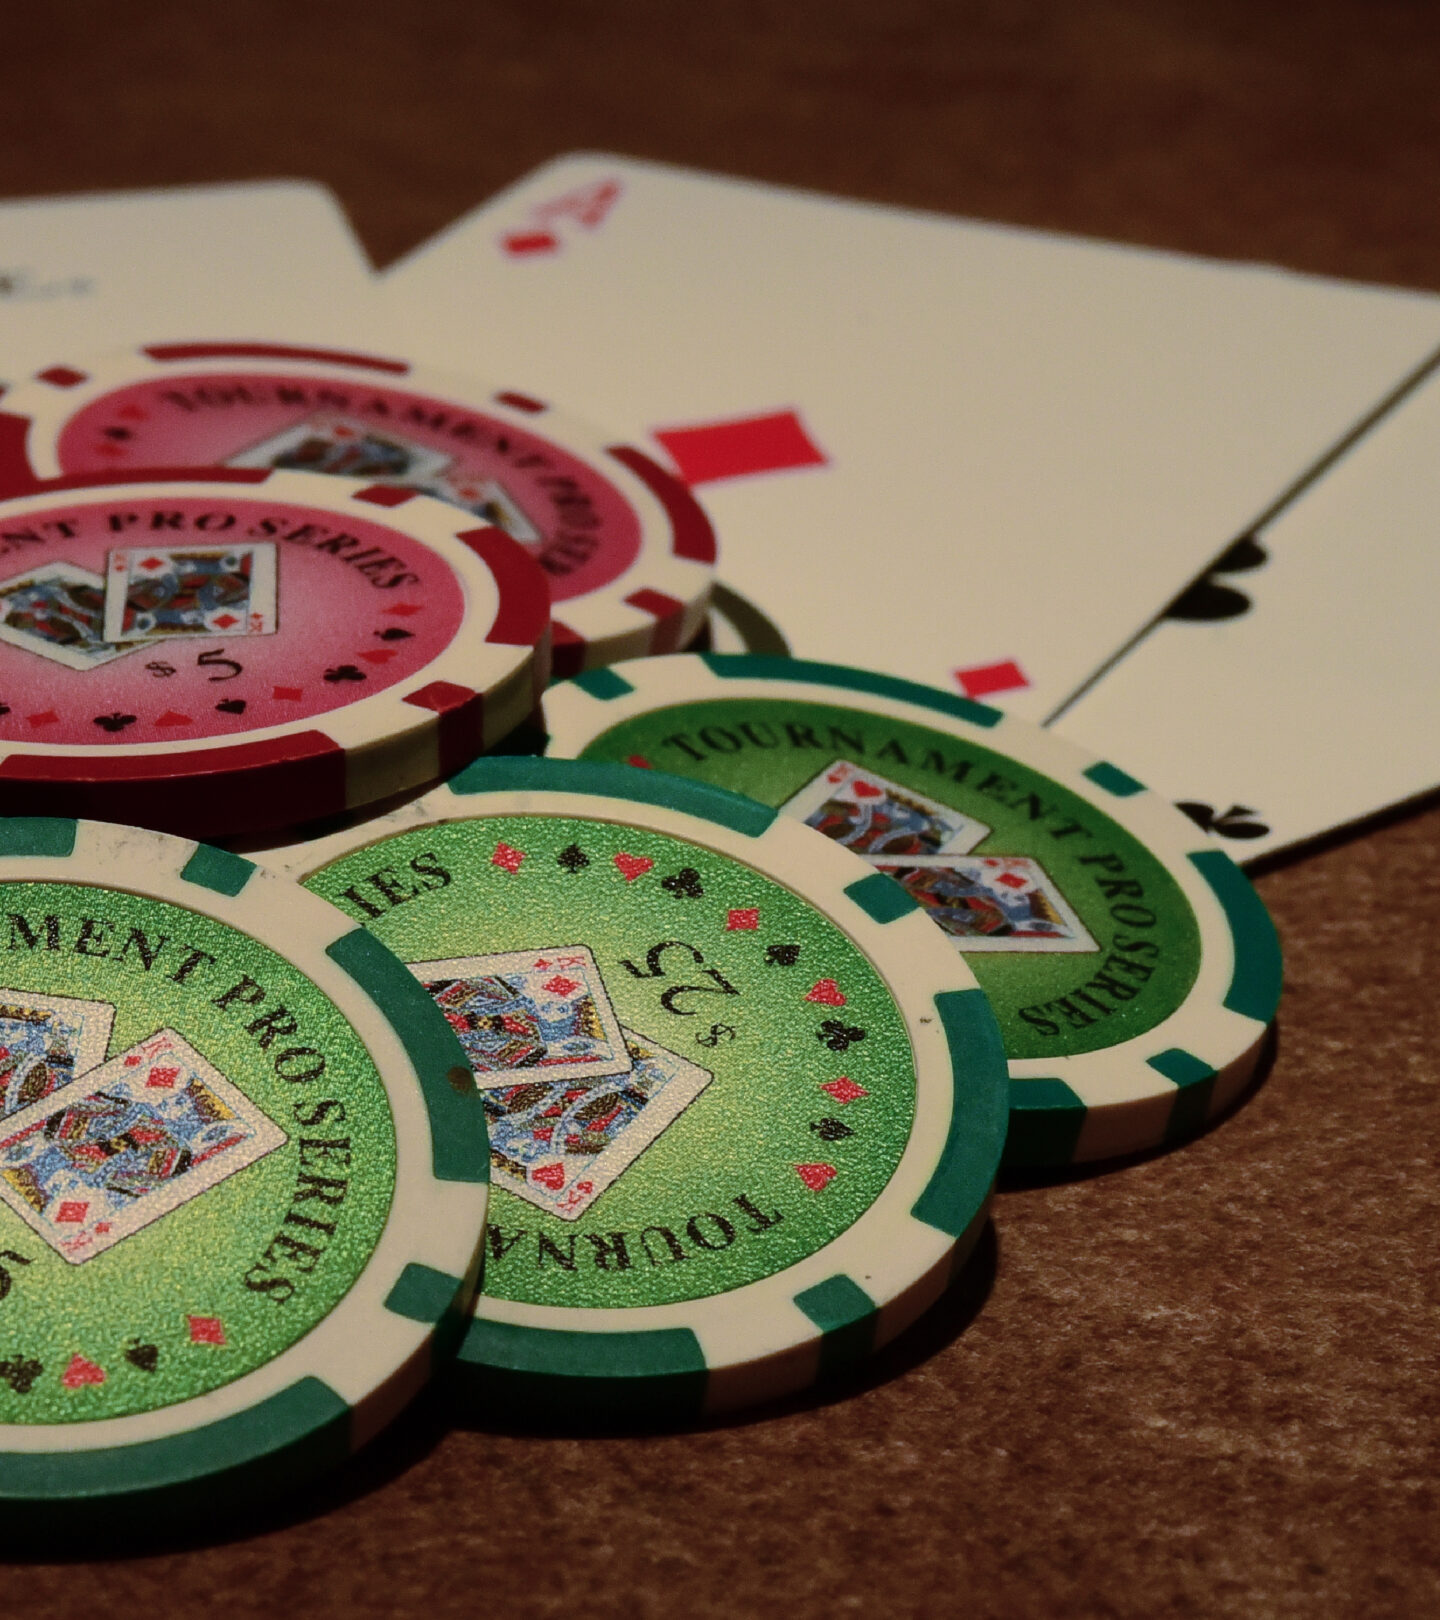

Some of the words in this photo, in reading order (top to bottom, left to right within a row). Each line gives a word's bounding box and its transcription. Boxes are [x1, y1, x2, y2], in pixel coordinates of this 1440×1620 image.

[109, 510, 236, 532] PRO
[248, 516, 420, 589] SERIES
[662, 721, 1093, 840] TOURNAMENT
[1079, 854, 1157, 928] PRO
[211, 974, 326, 1083] PRO
[1018, 934, 1159, 1036] SERIES
[245, 1100, 352, 1305] SERIES
